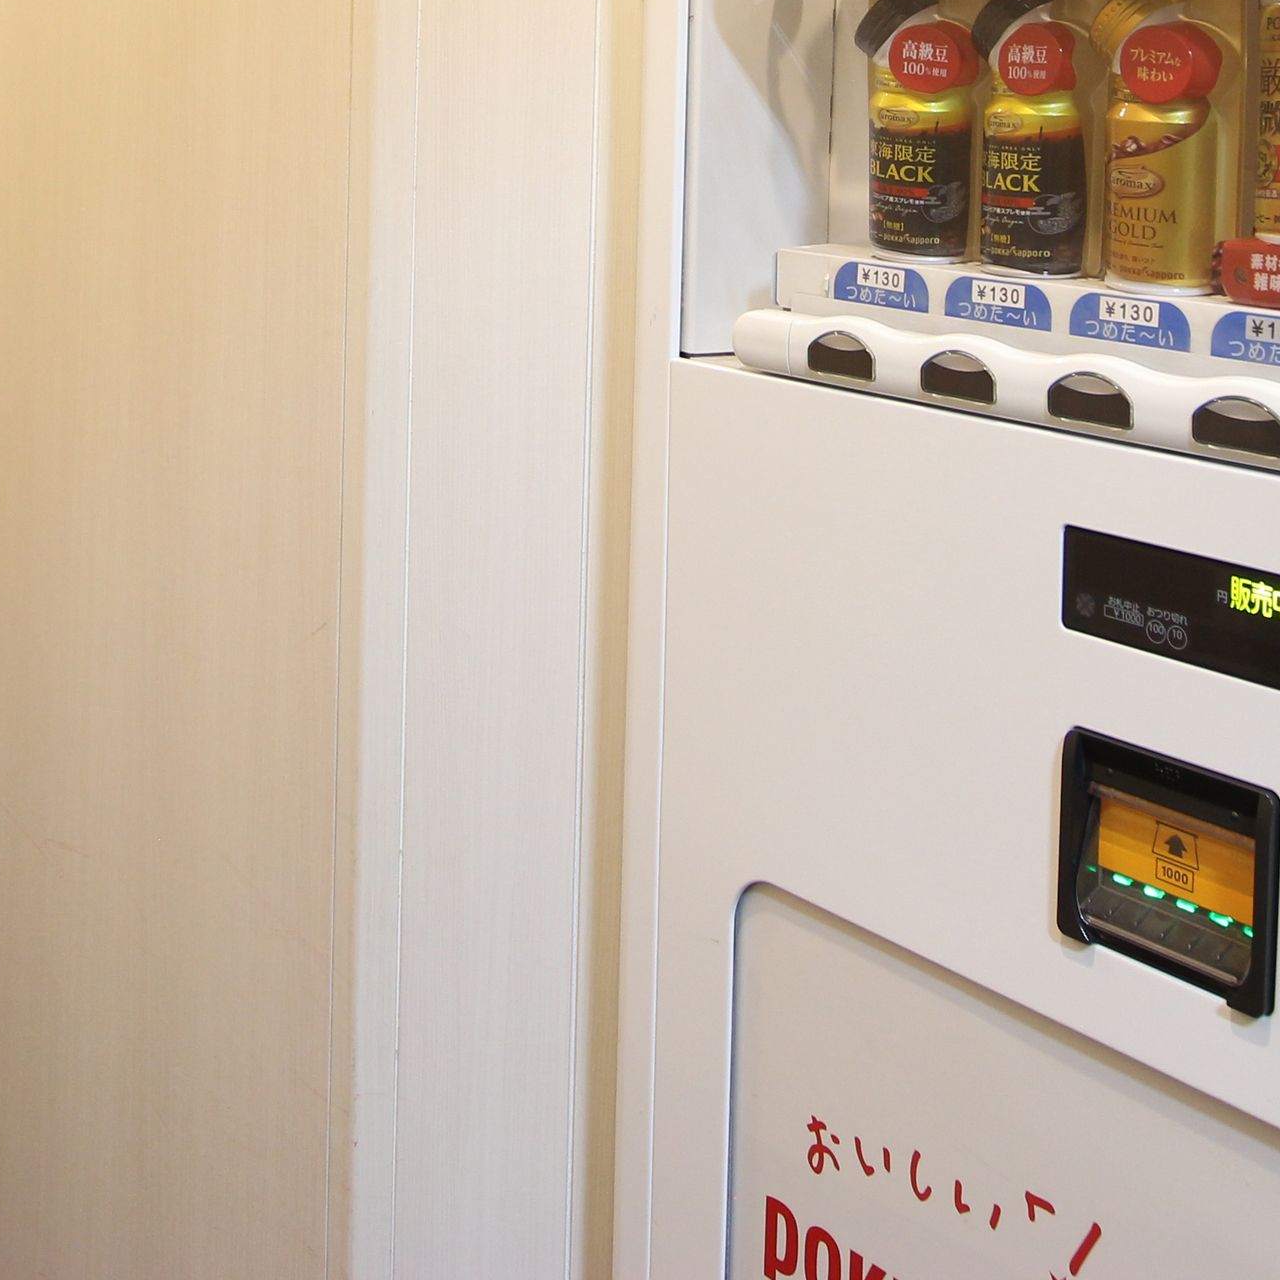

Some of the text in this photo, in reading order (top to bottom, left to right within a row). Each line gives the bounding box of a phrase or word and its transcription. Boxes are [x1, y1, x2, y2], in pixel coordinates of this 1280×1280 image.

[902, 40, 949, 63] 高級豆
[1008, 44, 1048, 65] 高級豆
[1130, 48, 1182, 67] プレミアムな
[1137, 66, 1174, 82] 味わい
[870, 159, 934, 183] BLACK
[1111, 202, 1177, 224] EMIUM
[862, 268, 902, 288] ¥130
[976, 285, 1021, 304] ¥130
[1104, 301, 1155, 324] ¥130
[1217, 589, 1228, 604] 円
[1172, 628, 1183, 640] 10
[1161, 865, 1189, 885] 1000
